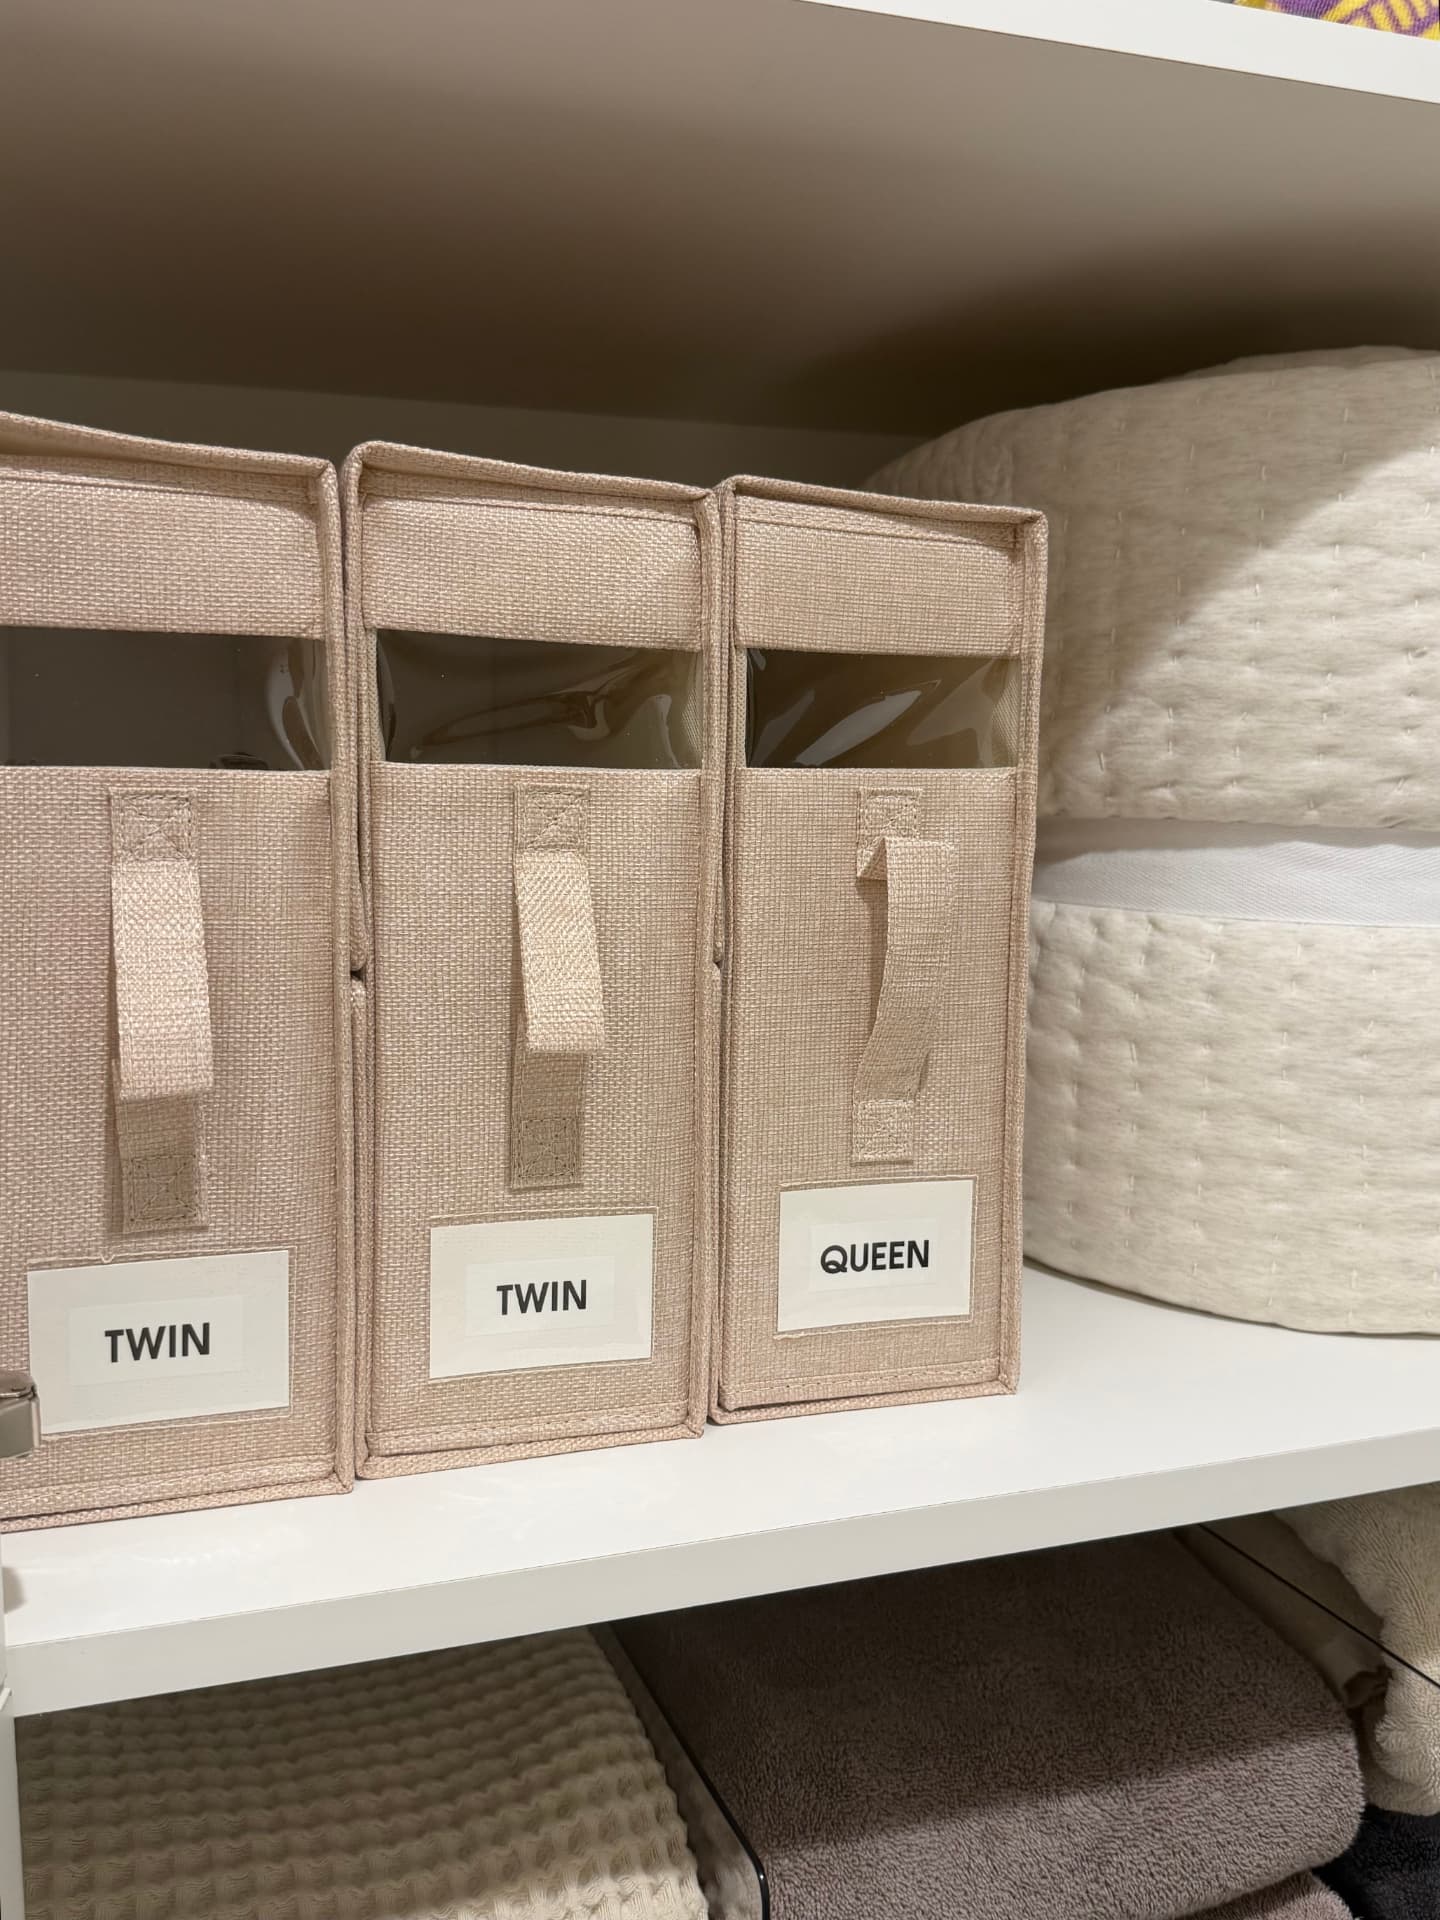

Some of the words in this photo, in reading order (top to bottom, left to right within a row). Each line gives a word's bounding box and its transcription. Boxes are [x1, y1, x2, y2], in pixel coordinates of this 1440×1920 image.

[820, 1239, 930, 1275] QUEEN
[496, 1279, 587, 1316] TWIN
[104, 1322, 210, 1363] TWIN
